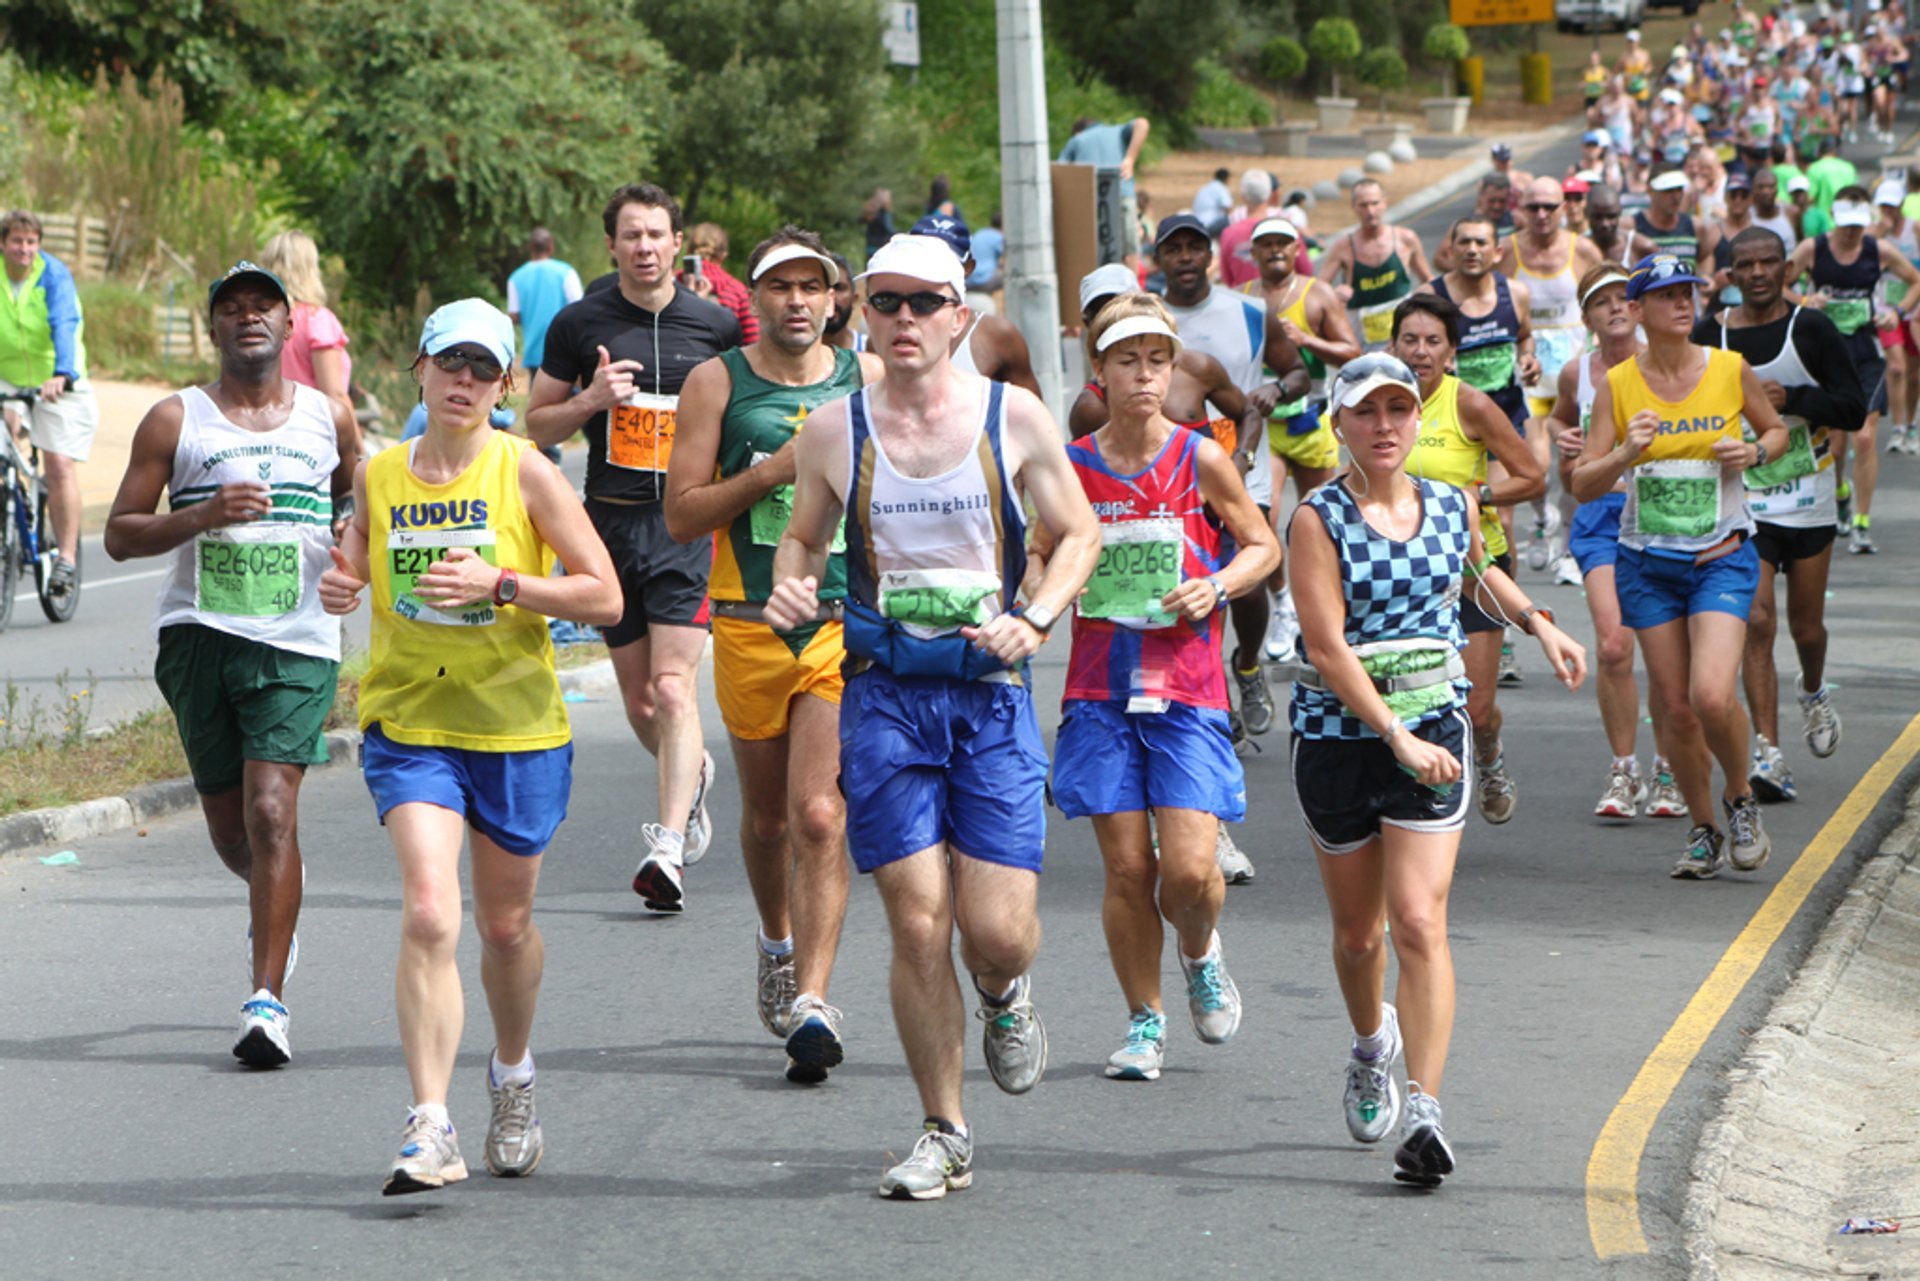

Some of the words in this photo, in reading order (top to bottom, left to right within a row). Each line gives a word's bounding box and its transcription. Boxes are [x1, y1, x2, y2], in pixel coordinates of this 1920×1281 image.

[390, 499, 488, 530] KUDUS
[871, 493, 989, 516] Sunninghill
[202, 543, 297, 576] E26028
[271, 588, 297, 611] 40
